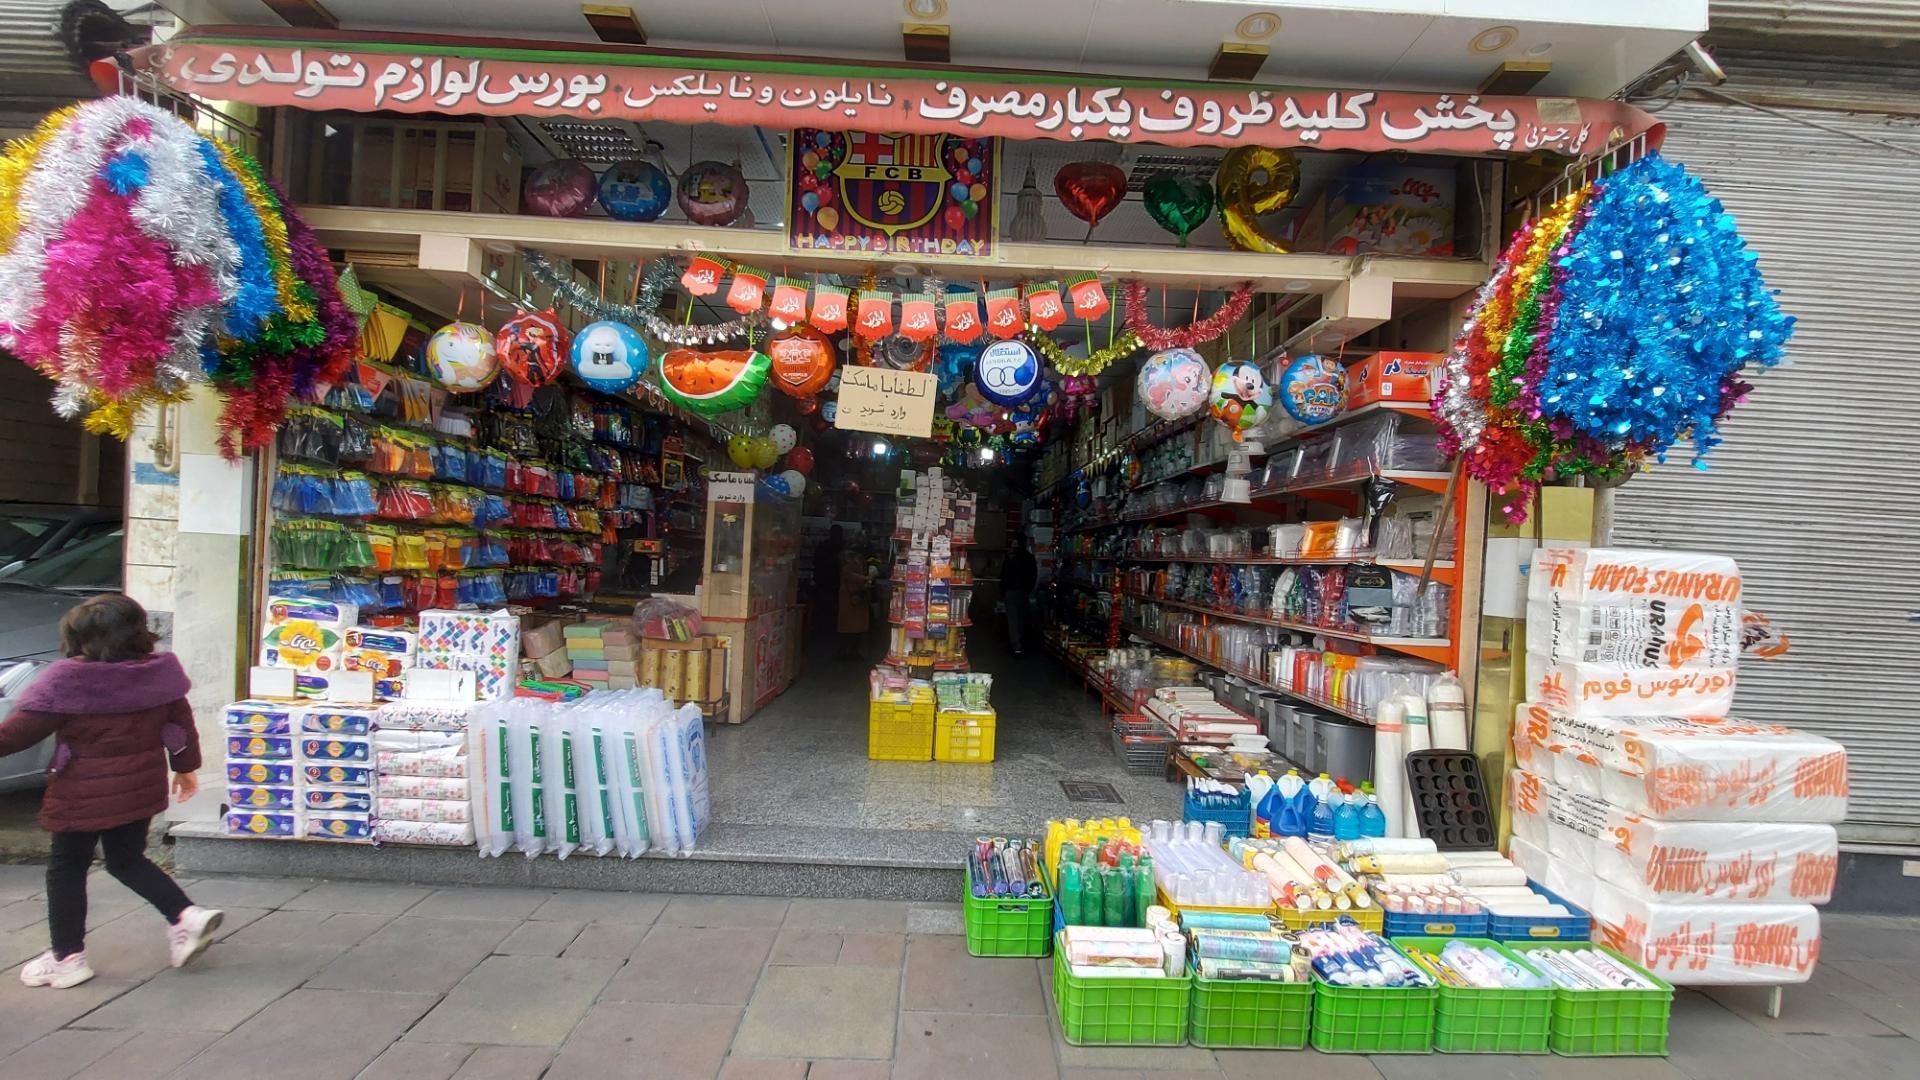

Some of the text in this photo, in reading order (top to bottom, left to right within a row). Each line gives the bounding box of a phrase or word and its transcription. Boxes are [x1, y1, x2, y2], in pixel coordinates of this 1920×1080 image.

[180, 48, 366, 98] تولدی
[374, 57, 481, 106] لوازم
[477, 71, 606, 112] بورس
[622, 73, 753, 111] نایلکس
[756, 84, 773, 104] و
[779, 81, 893, 116] نایلون
[919, 81, 1047, 125] مصرف
[1138, 89, 1274, 137] ظروف
[1279, 92, 1375, 142] کلیه
[1380, 95, 1516, 149] پخش
[863, 167, 923, 181] FCB
[797, 233, 985, 256] HAPPY BIRTHDAY
[842, 369, 878, 392] ماسک
[860, 402, 885, 418] شوید
[890, 405, 907, 420] وارد
[1589, 563, 1742, 602] URANUS FOAM
[1583, 669, 1736, 701] اورانوس فوم
